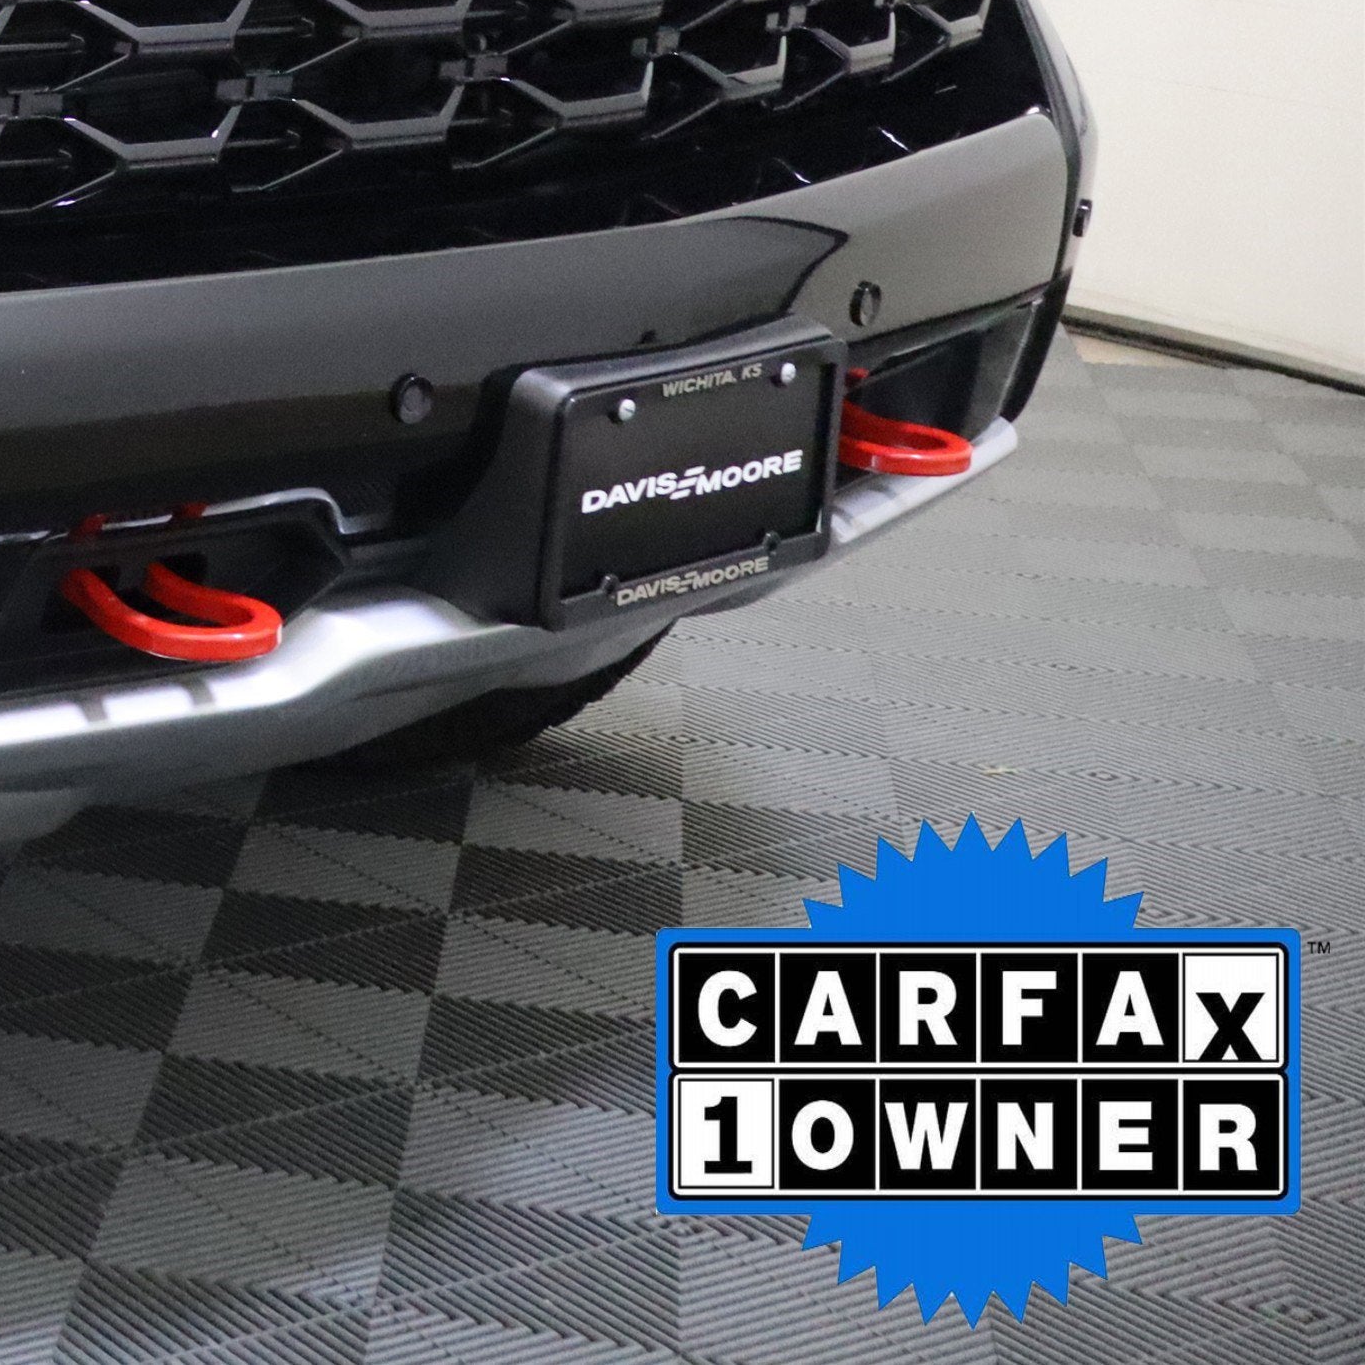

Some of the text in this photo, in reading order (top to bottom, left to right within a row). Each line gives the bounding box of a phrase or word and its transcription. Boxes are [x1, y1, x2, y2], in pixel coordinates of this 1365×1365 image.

[741, 362, 763, 379] KS
[581, 449, 803, 514] DAVIS MOORE
[616, 555, 769, 607] DAVIS MOORE
